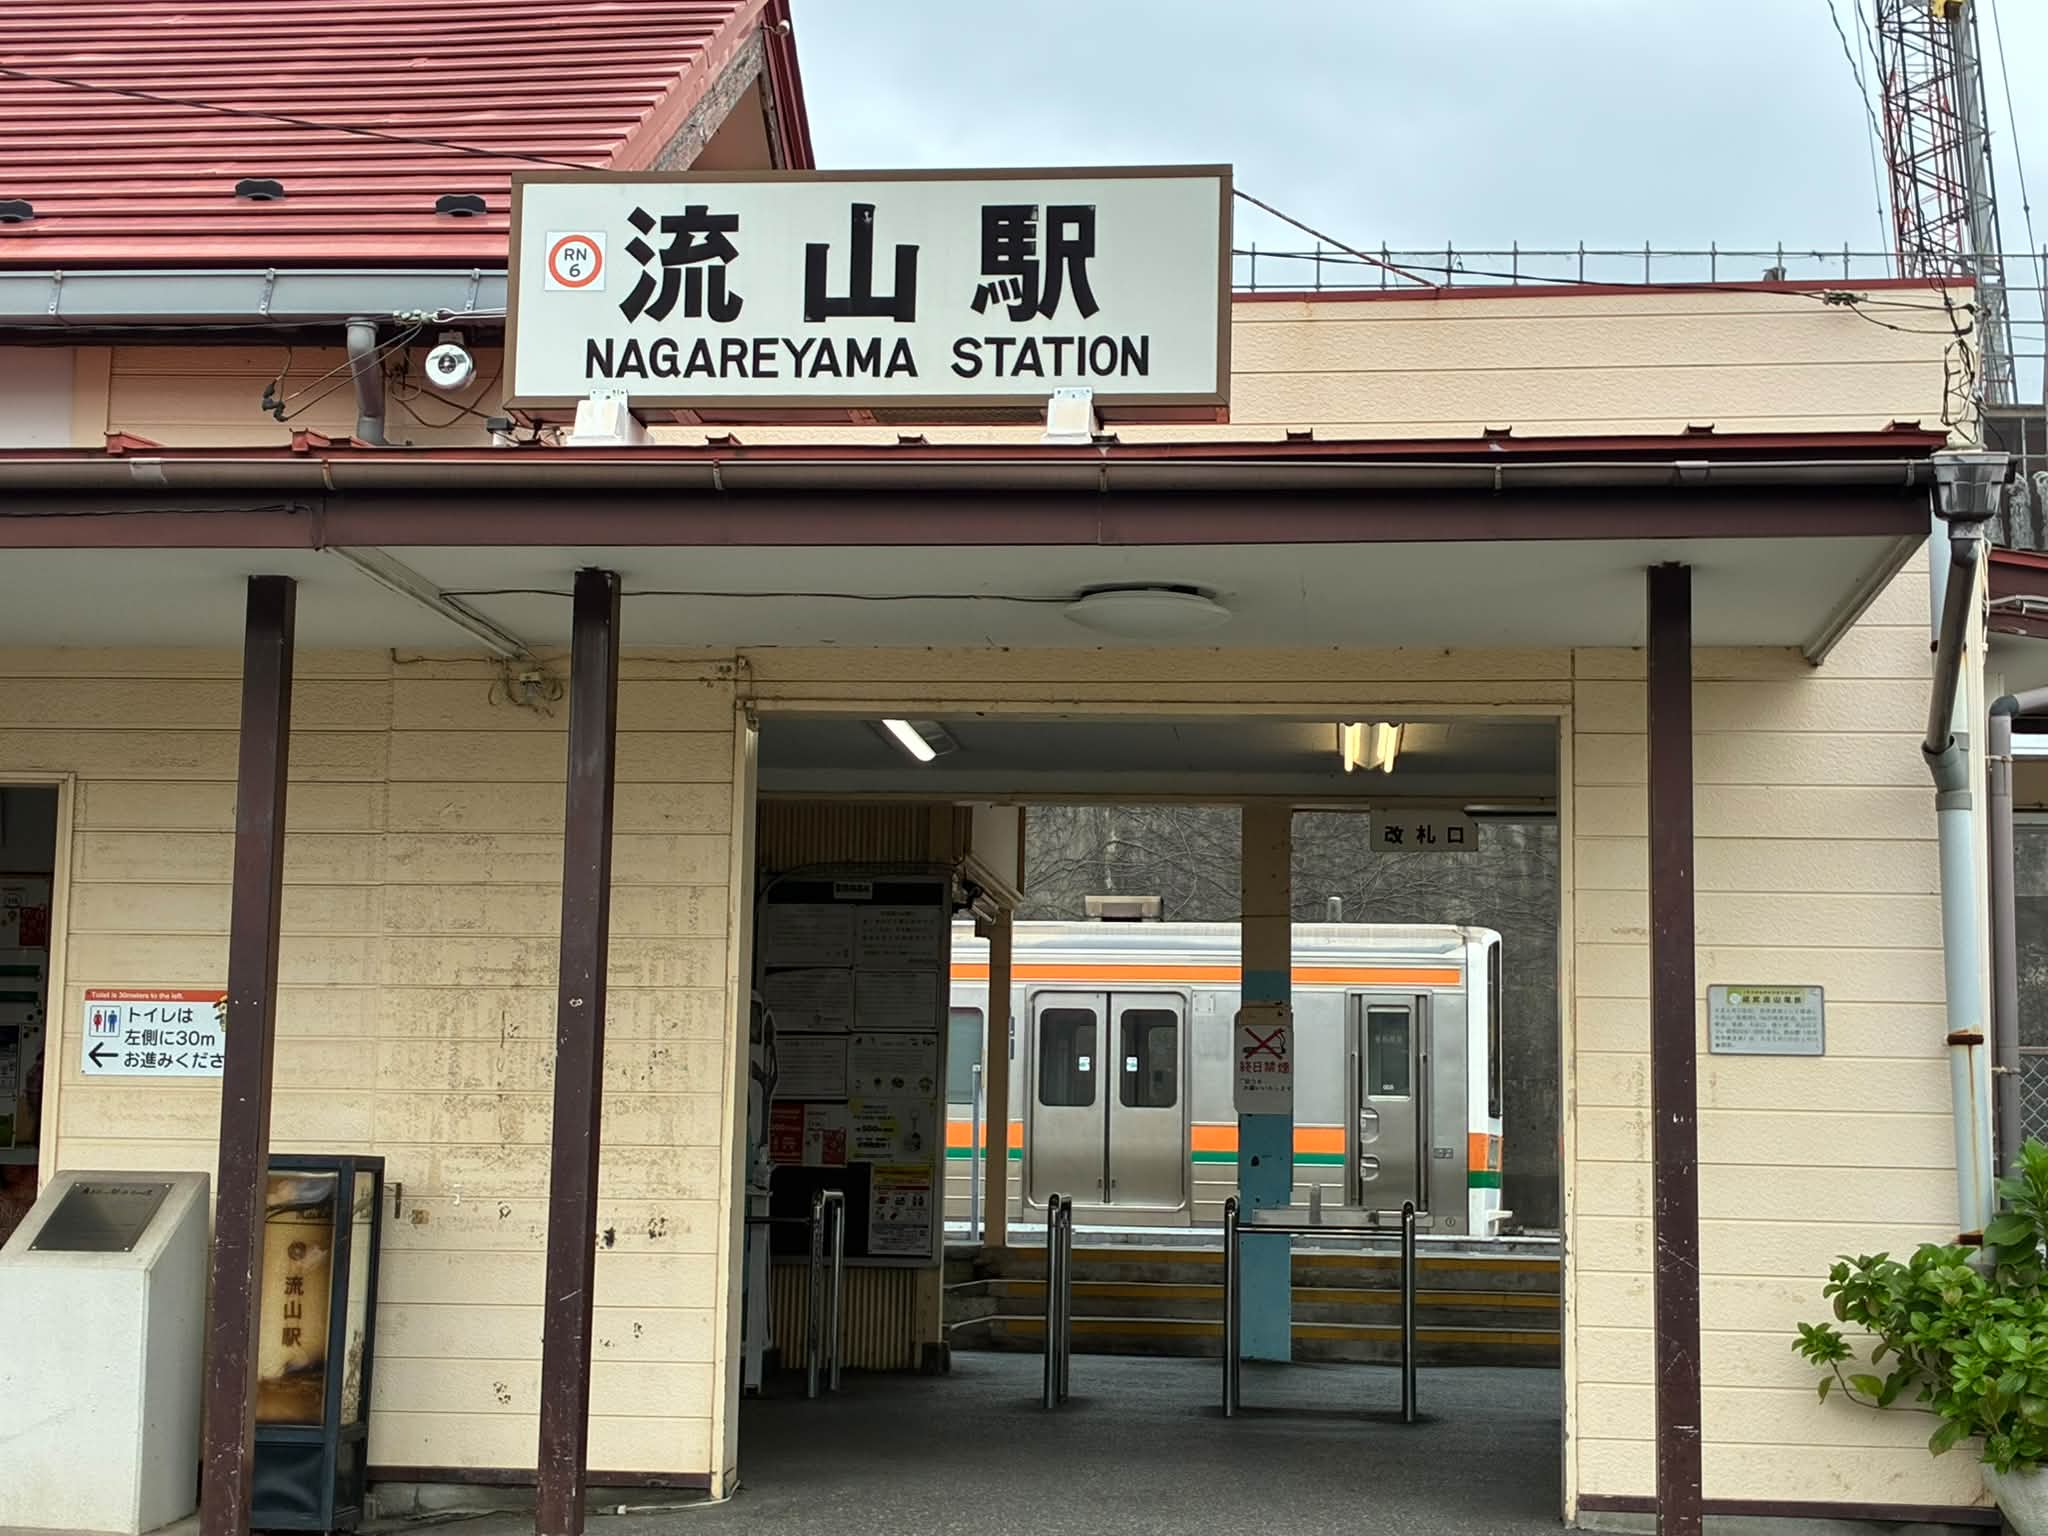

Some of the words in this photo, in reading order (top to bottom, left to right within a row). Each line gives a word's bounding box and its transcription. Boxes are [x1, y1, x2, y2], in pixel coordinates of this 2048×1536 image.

[564, 247, 588, 261] RN
[569, 263, 581, 278] 6
[619, 202, 1100, 324] 流山駅
[585, 336, 918, 380] NAGAREYAMA
[951, 334, 1149, 378] STATION
[1383, 824, 1465, 845] 改札口
[129, 1006, 194, 1023] トイレは
[124, 1029, 215, 1046] 左側に30m
[1239, 1061, 1290, 1074] 終日禁煙
[281, 1275, 305, 1347] 流山駅
